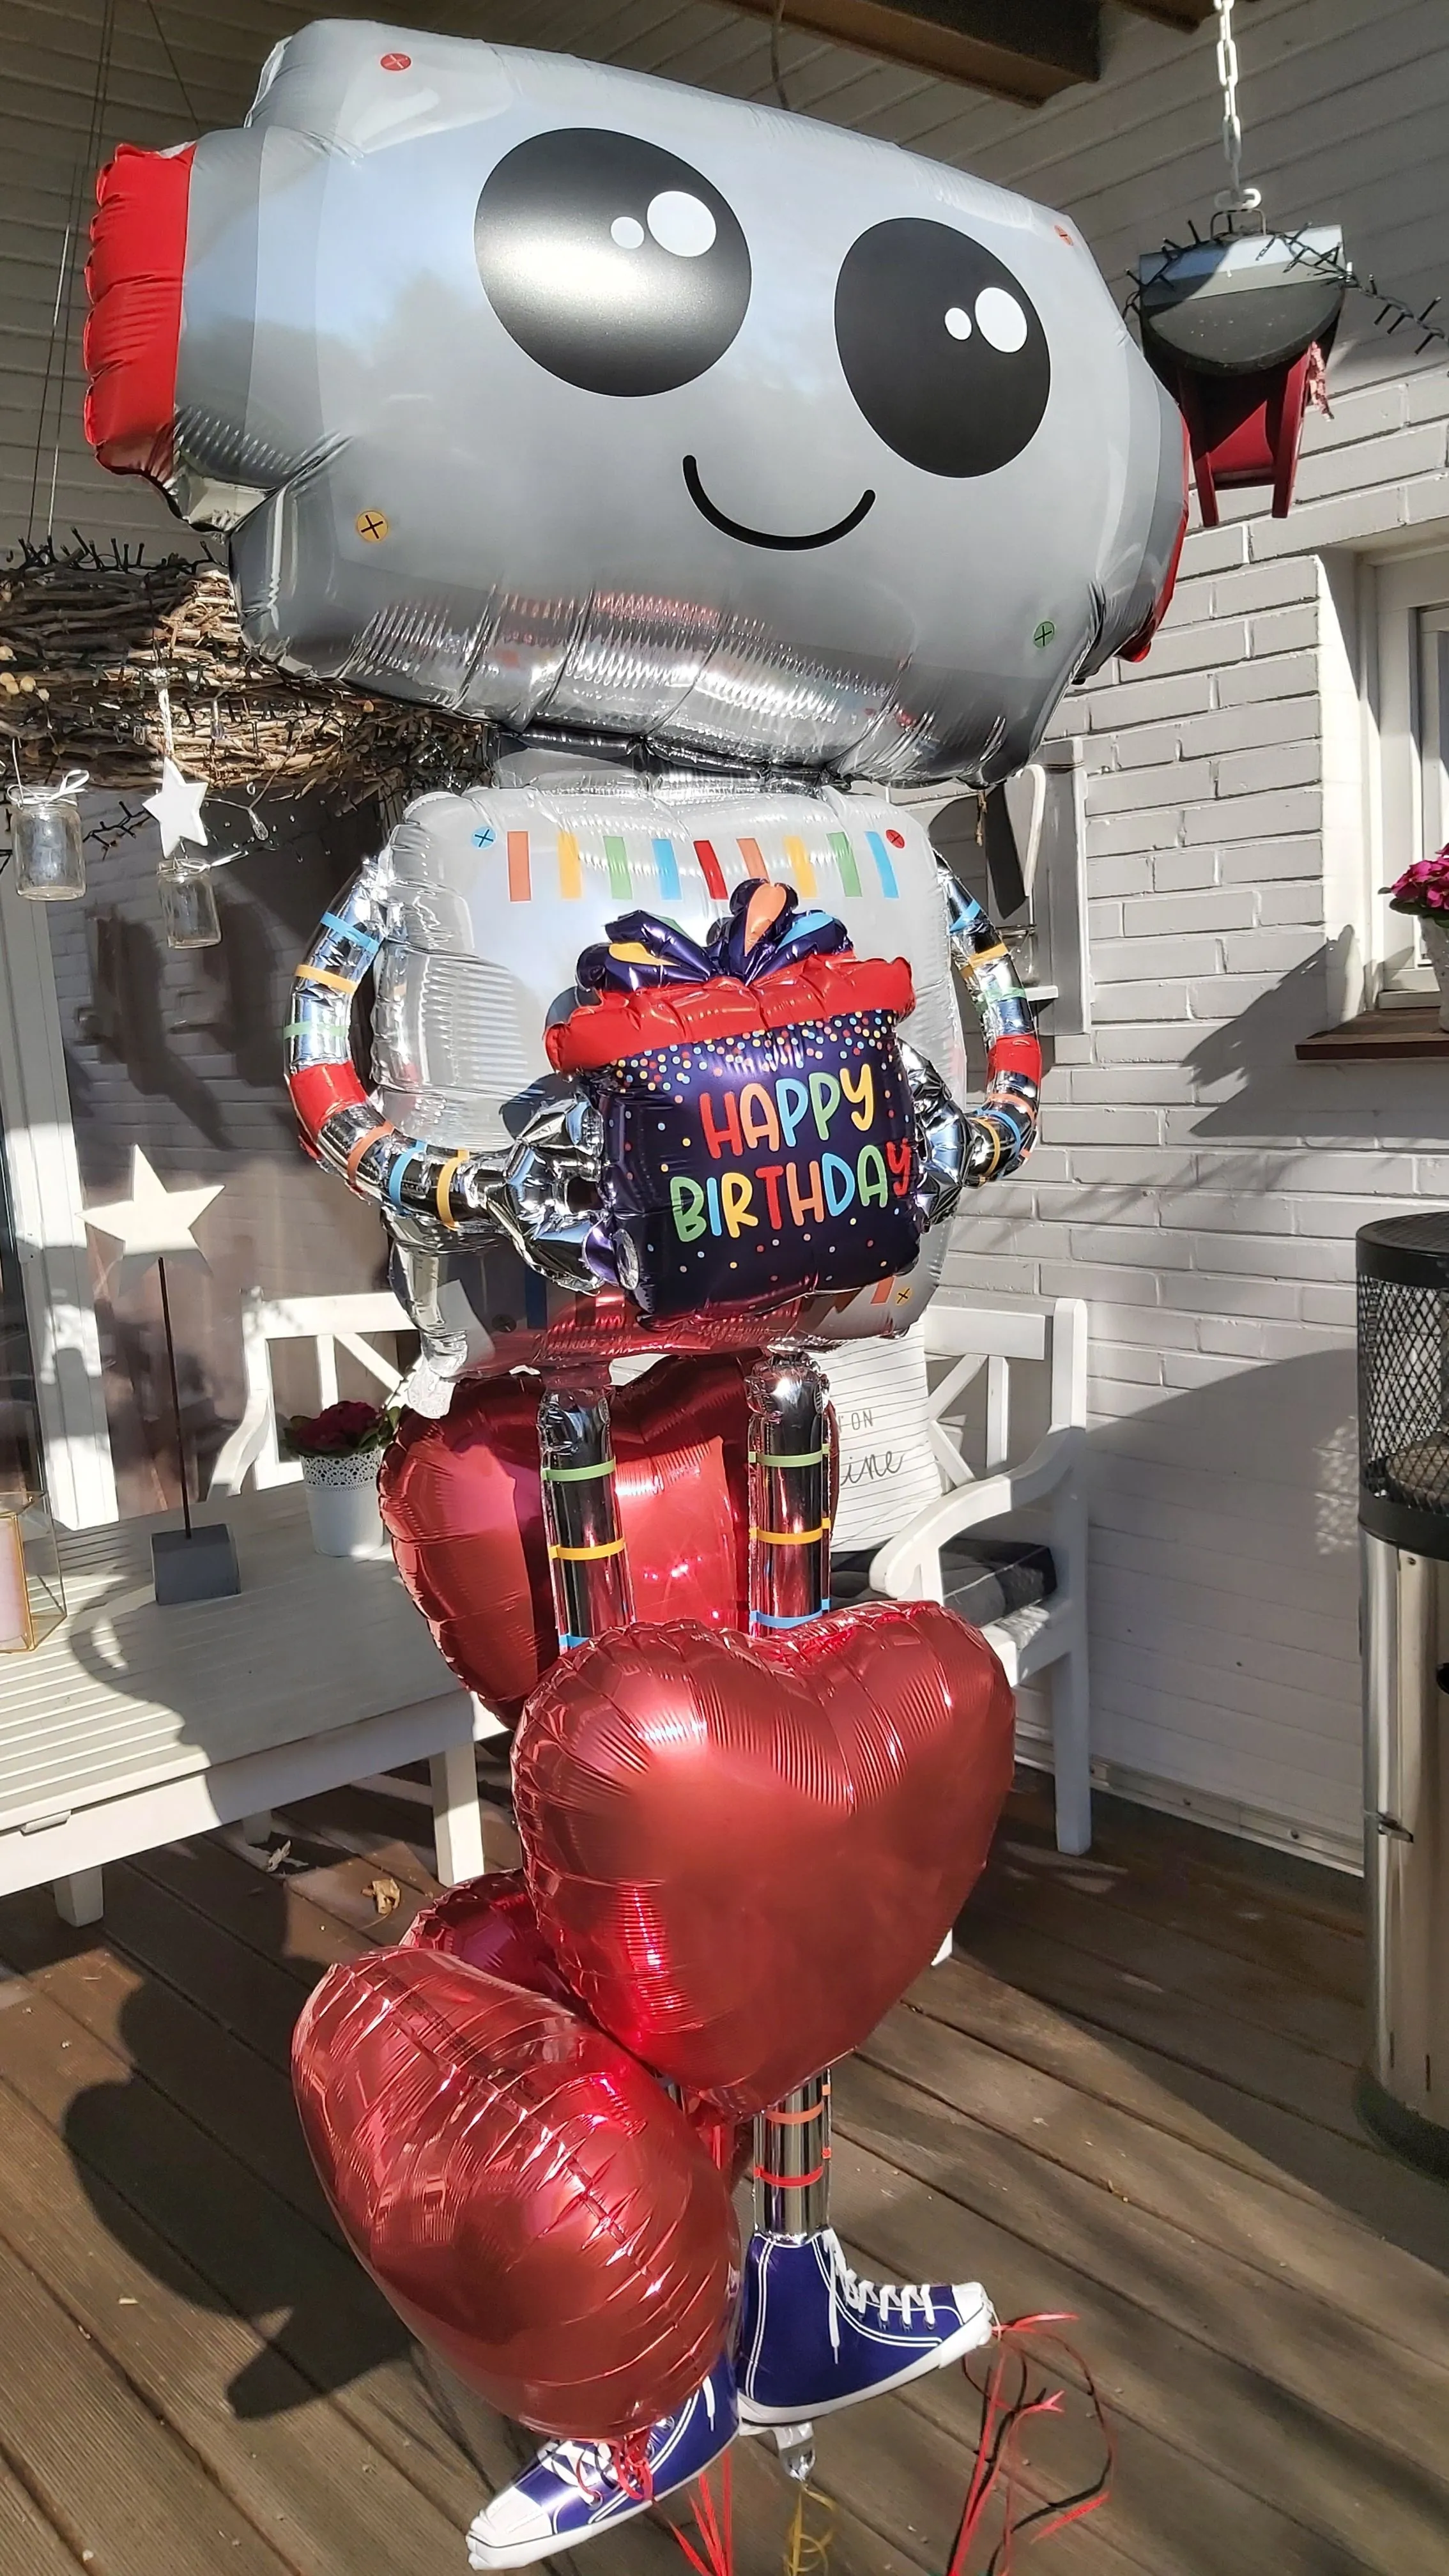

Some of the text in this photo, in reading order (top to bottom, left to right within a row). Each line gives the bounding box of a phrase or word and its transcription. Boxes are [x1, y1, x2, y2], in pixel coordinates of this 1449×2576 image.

[700, 1063, 874, 1159] HAPPY
[670, 1138, 912, 1242] BIRTHDAY
[839, 1451, 905, 1485] ine
